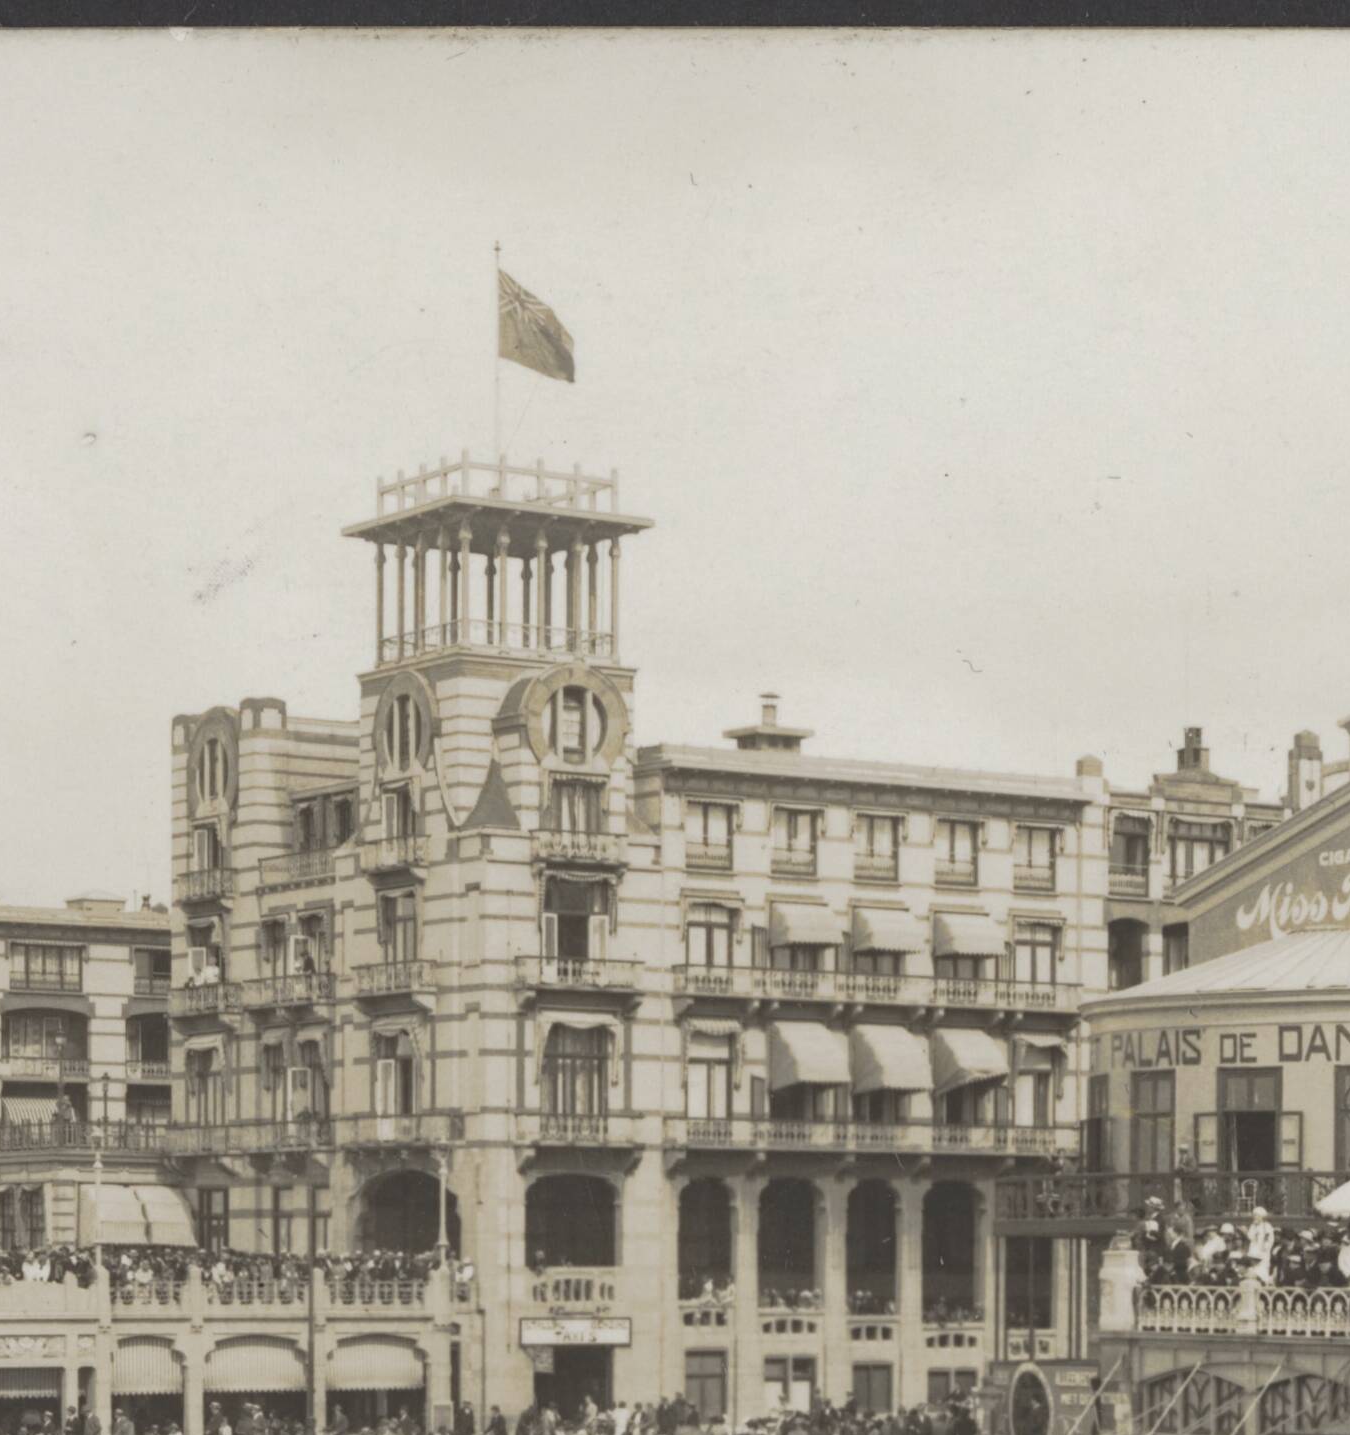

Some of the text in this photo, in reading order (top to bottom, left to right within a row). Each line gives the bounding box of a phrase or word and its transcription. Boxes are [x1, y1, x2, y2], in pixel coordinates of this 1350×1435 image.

[1236, 881, 1329, 942] Miss
[1110, 1028, 1202, 1069] PALAIS
[1219, 1033, 1258, 1064] DE
